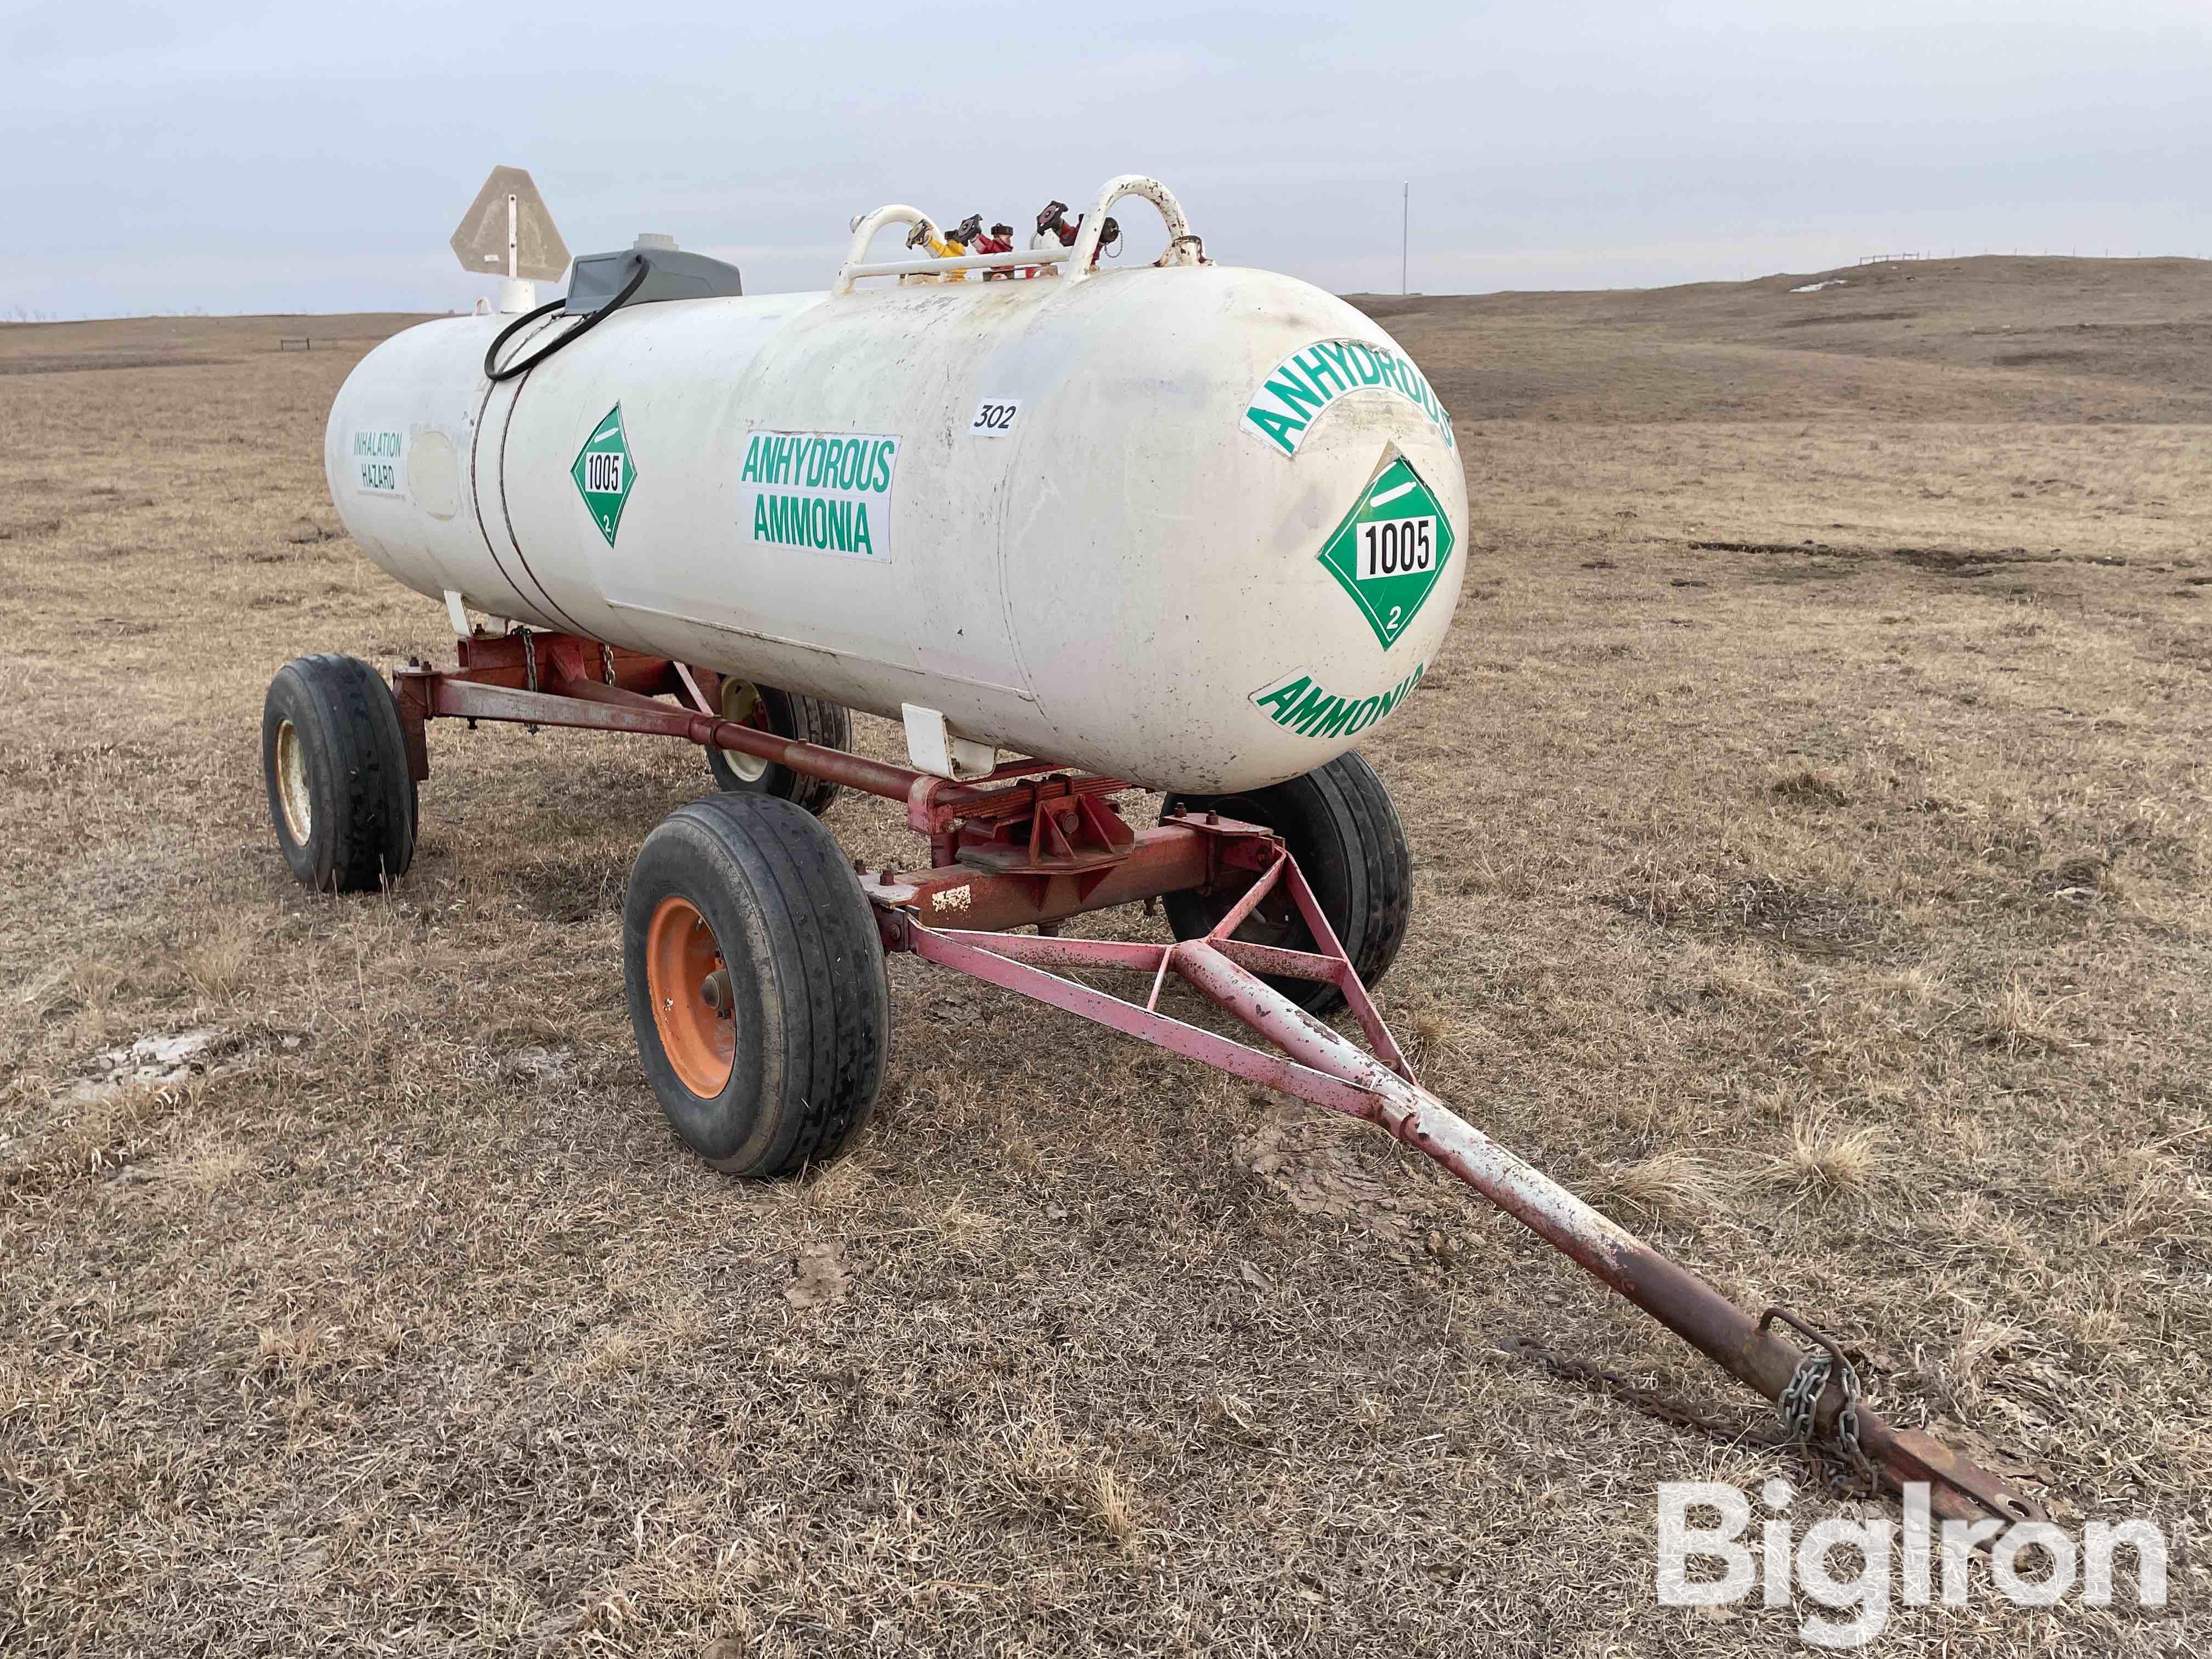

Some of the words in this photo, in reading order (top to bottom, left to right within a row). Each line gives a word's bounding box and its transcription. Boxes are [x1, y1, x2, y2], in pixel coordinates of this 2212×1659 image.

[1246, 341, 1453, 454] ANHYDROUS
[974, 404, 1017, 429] 302
[353, 432, 403, 458] INHALATION
[361, 464, 395, 489] HAZARD
[589, 455, 620, 491] 1005
[741, 436, 895, 493] ANHYDROUS
[603, 515, 611, 532] 2
[754, 494, 873, 555] AMMONIA
[1365, 520, 1429, 575] 1005
[1386, 606, 1401, 630] 2
[1256, 662, 1423, 738] AMMONIA
